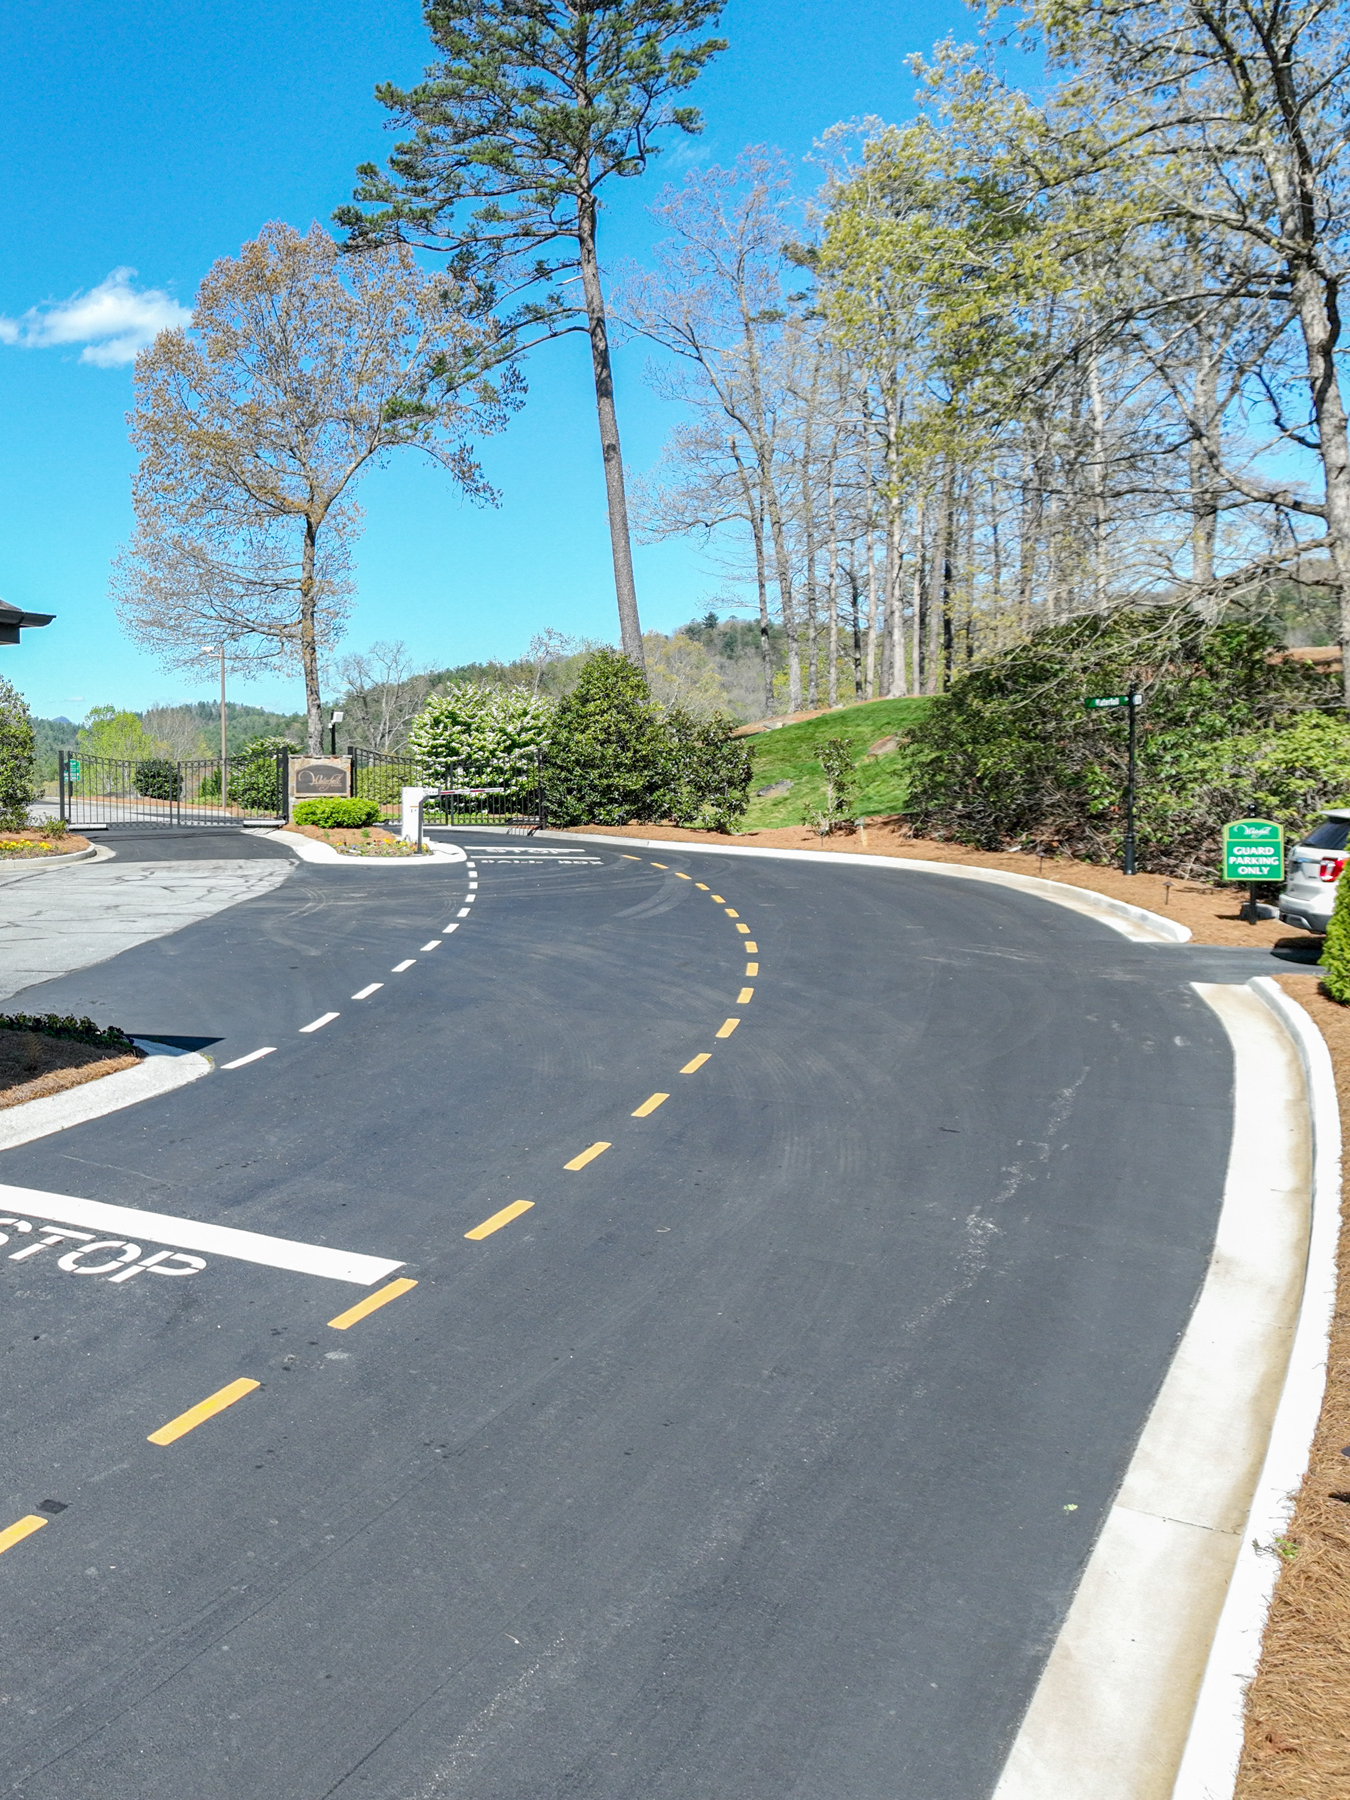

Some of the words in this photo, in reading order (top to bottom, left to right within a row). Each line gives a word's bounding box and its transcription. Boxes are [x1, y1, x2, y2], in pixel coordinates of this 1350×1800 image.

[1233, 846, 1275, 855] GUARD
[1228, 856, 1279, 865] PARKING
[1237, 866, 1270, 875] ONLY
